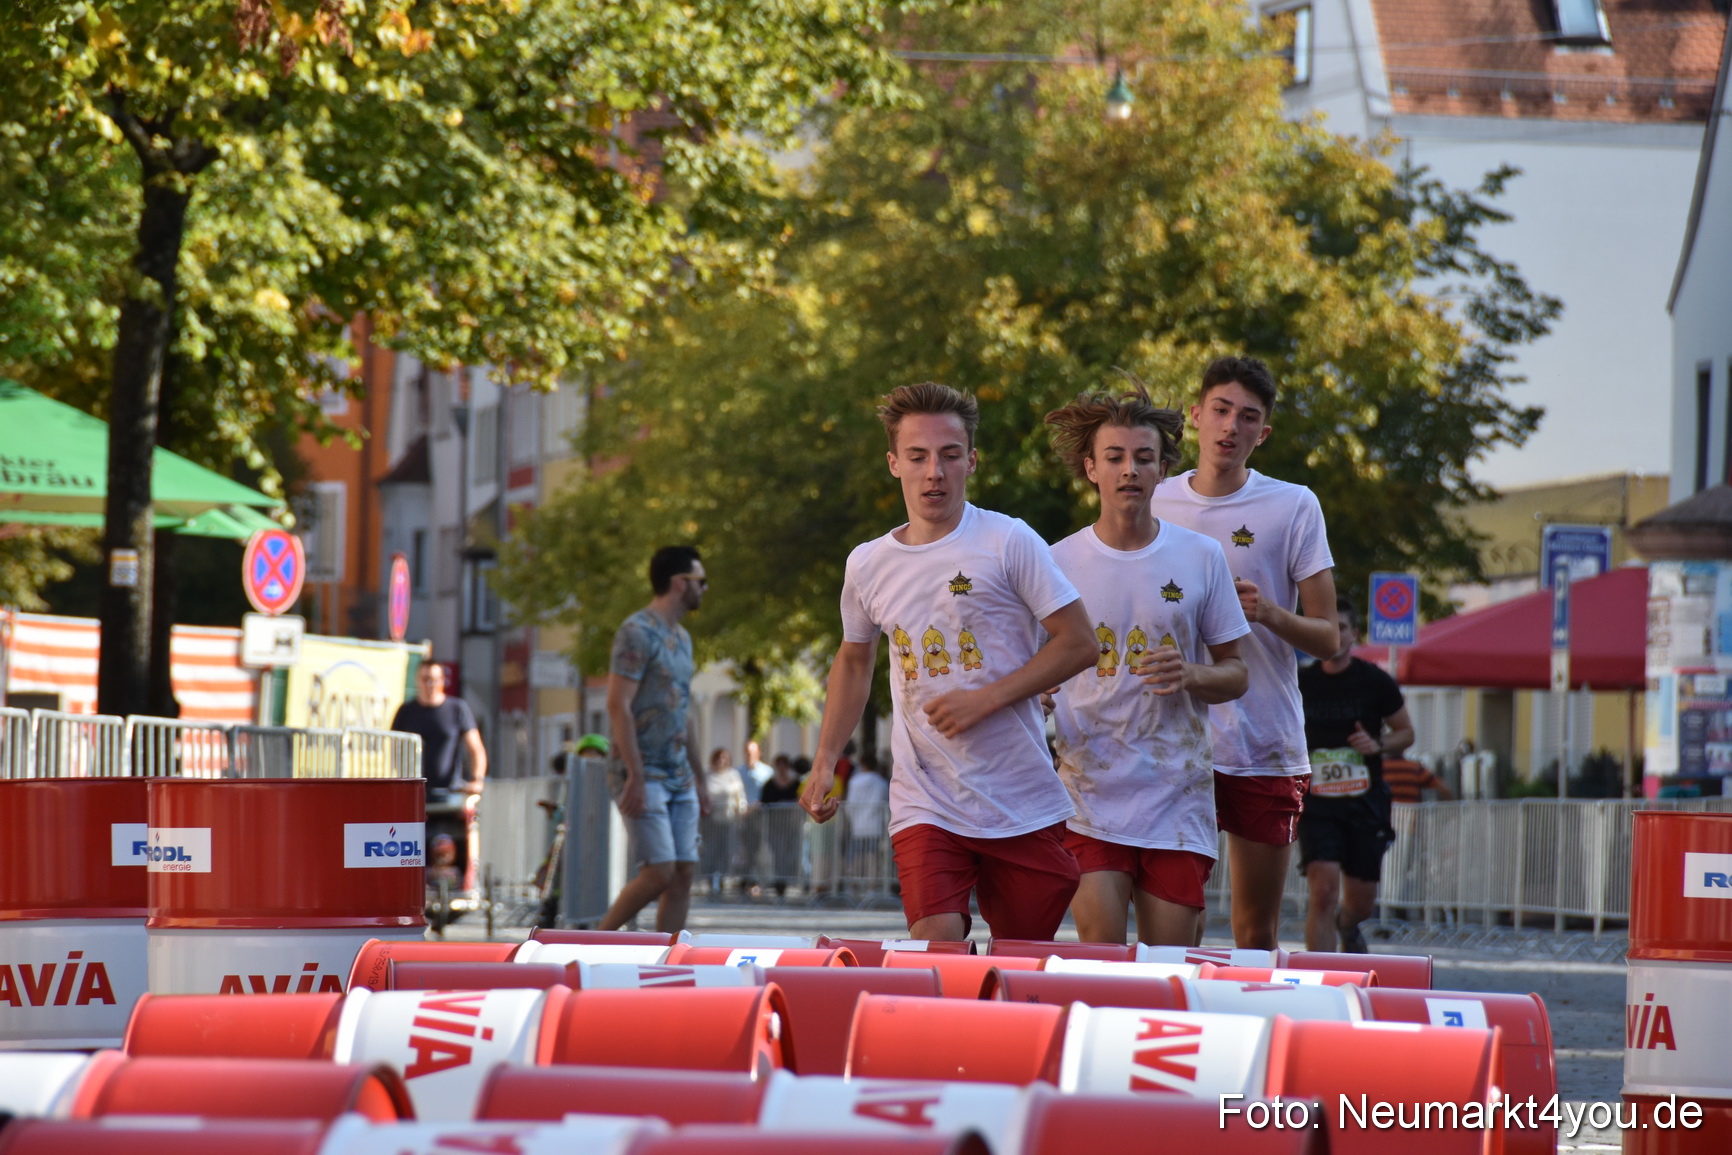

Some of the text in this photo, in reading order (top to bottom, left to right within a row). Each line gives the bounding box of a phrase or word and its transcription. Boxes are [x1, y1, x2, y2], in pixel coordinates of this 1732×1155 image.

[1232, 536, 1254, 544] WINGS
[949, 583, 972, 592] WINGS
[1161, 591, 1184, 599] WINGS
[1374, 621, 1410, 640] TAXI
[1321, 763, 1353, 781] 501
